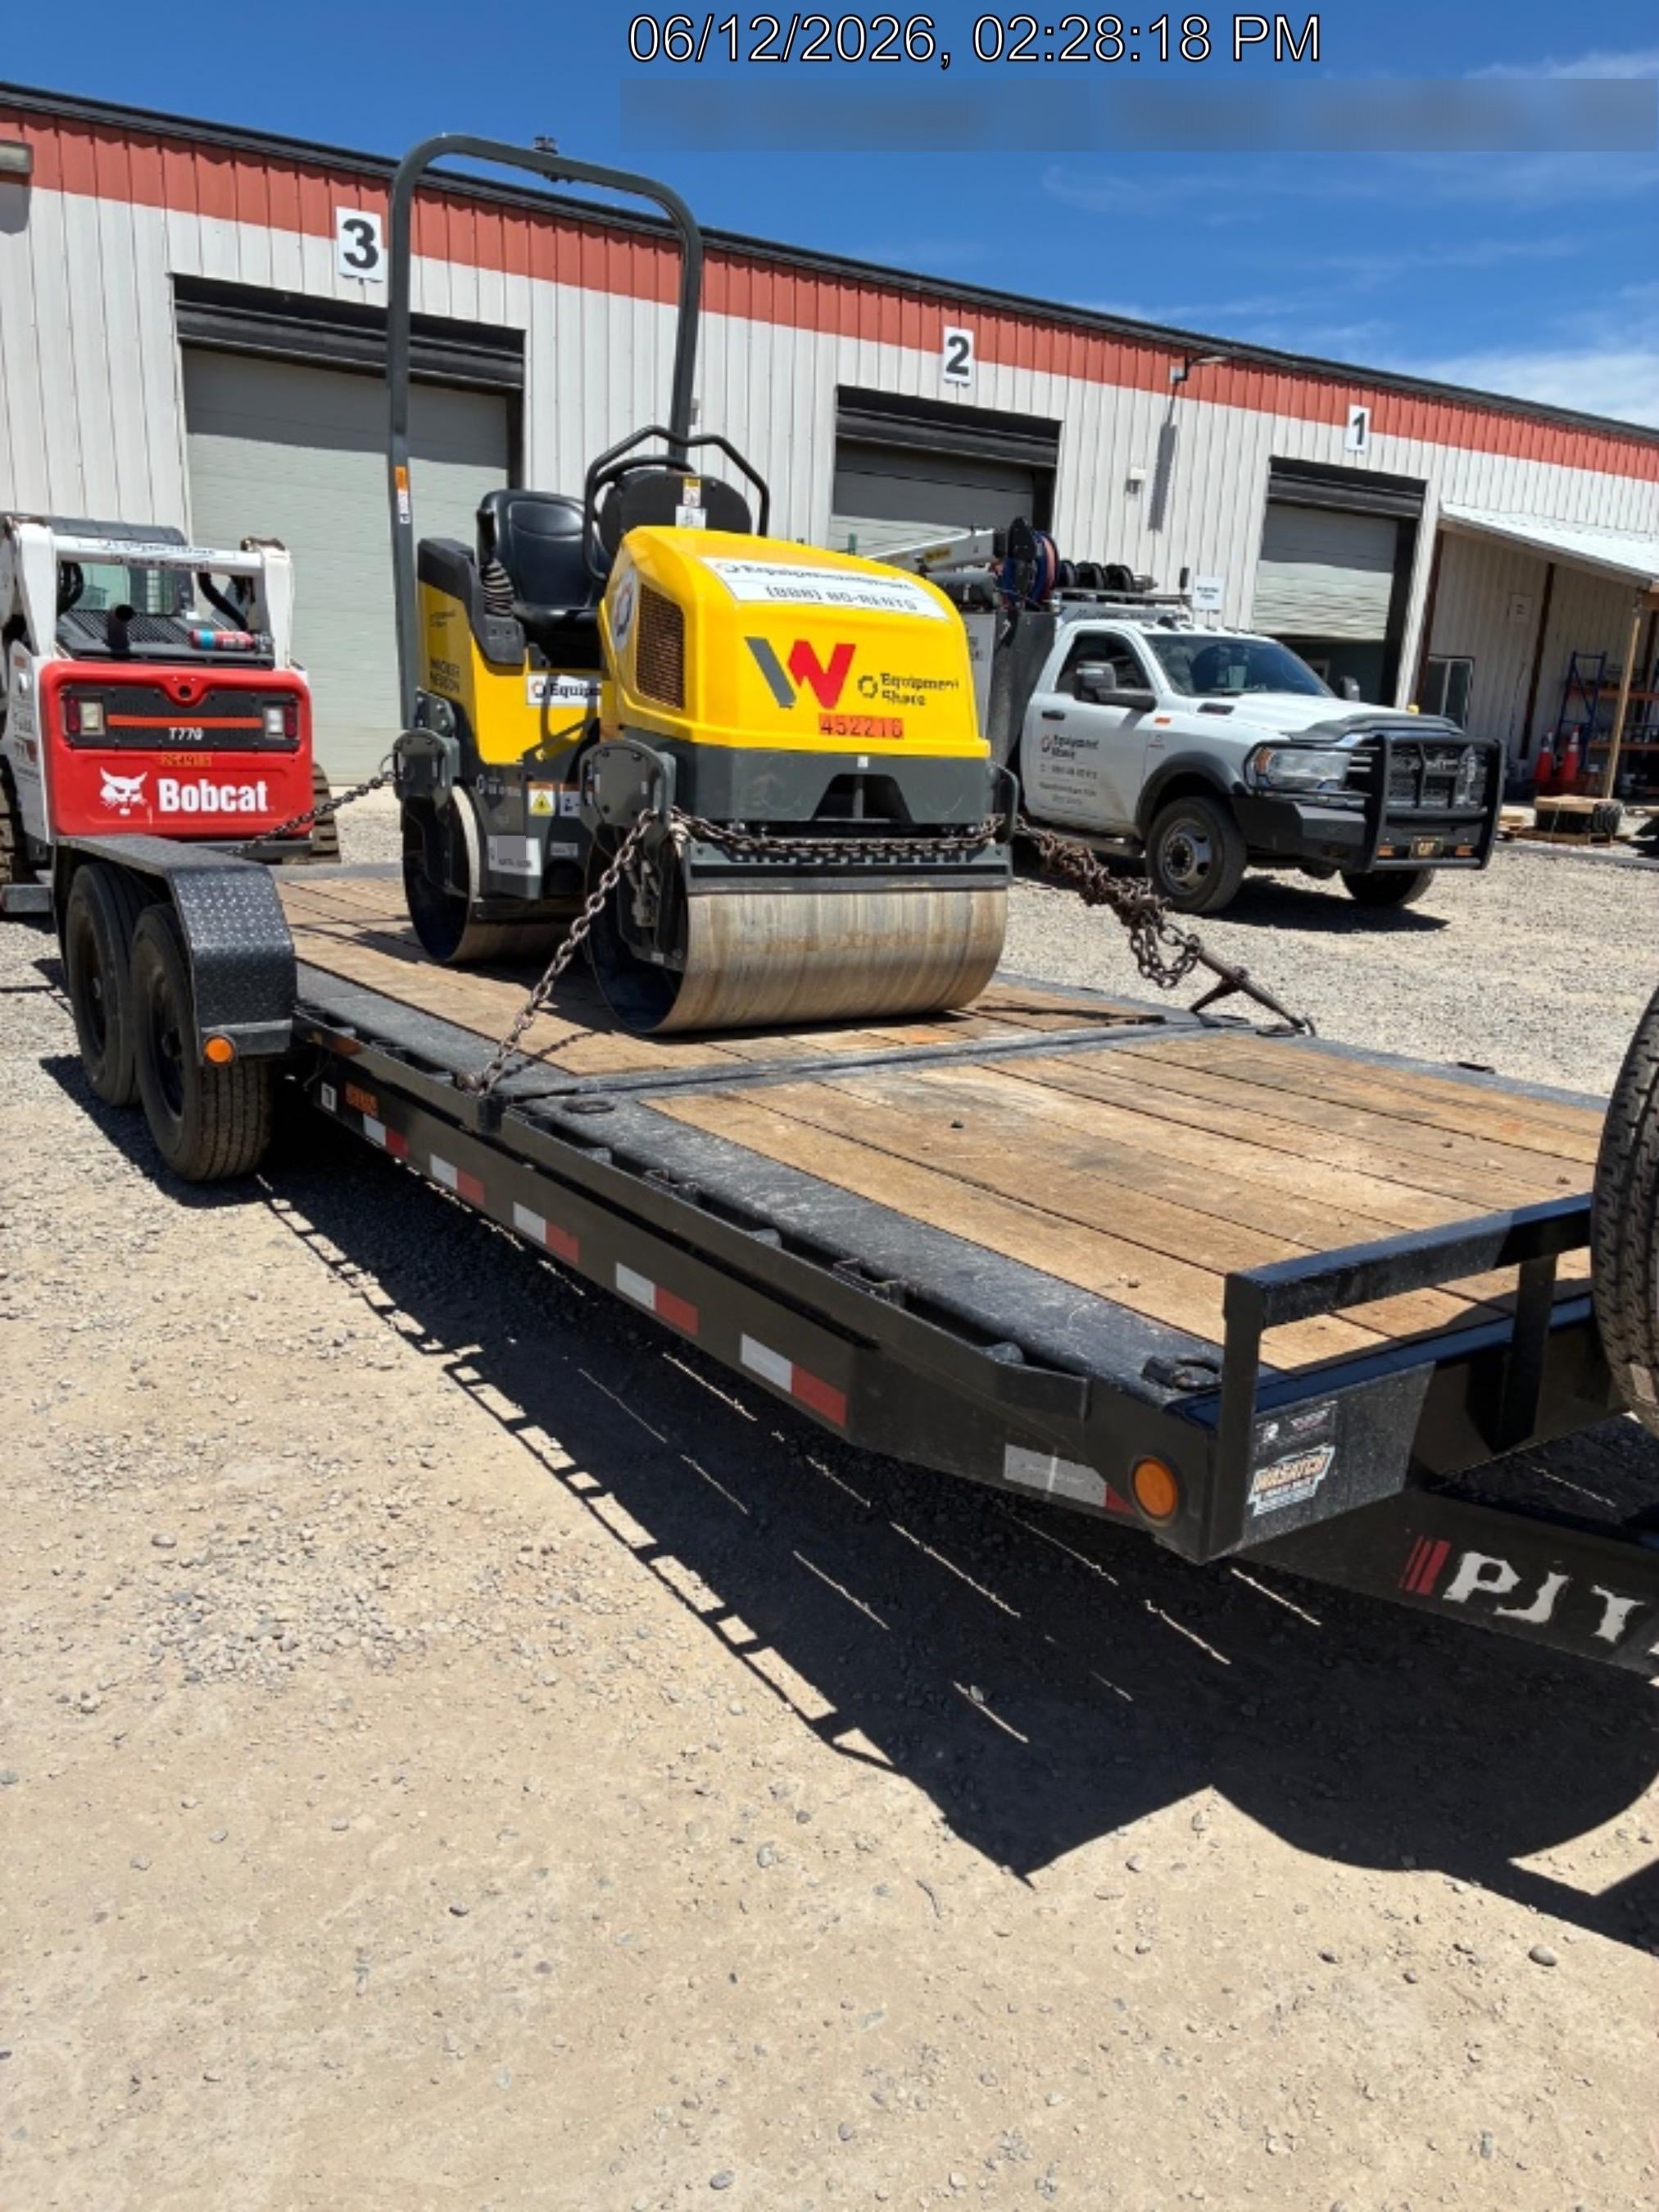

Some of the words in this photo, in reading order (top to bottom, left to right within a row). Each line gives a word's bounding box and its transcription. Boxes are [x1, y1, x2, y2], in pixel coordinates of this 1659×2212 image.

[342, 219, 378, 270] 3
[945, 336, 970, 376] 2
[1353, 412, 1366, 446] 1
[880, 673, 959, 691] Equipment
[881, 689, 926, 706] Share
[168, 726, 204, 741] T770
[820, 718, 904, 739] 452216
[157, 777, 269, 813] Bobcat
[1442, 1551, 1571, 1624] PJ
